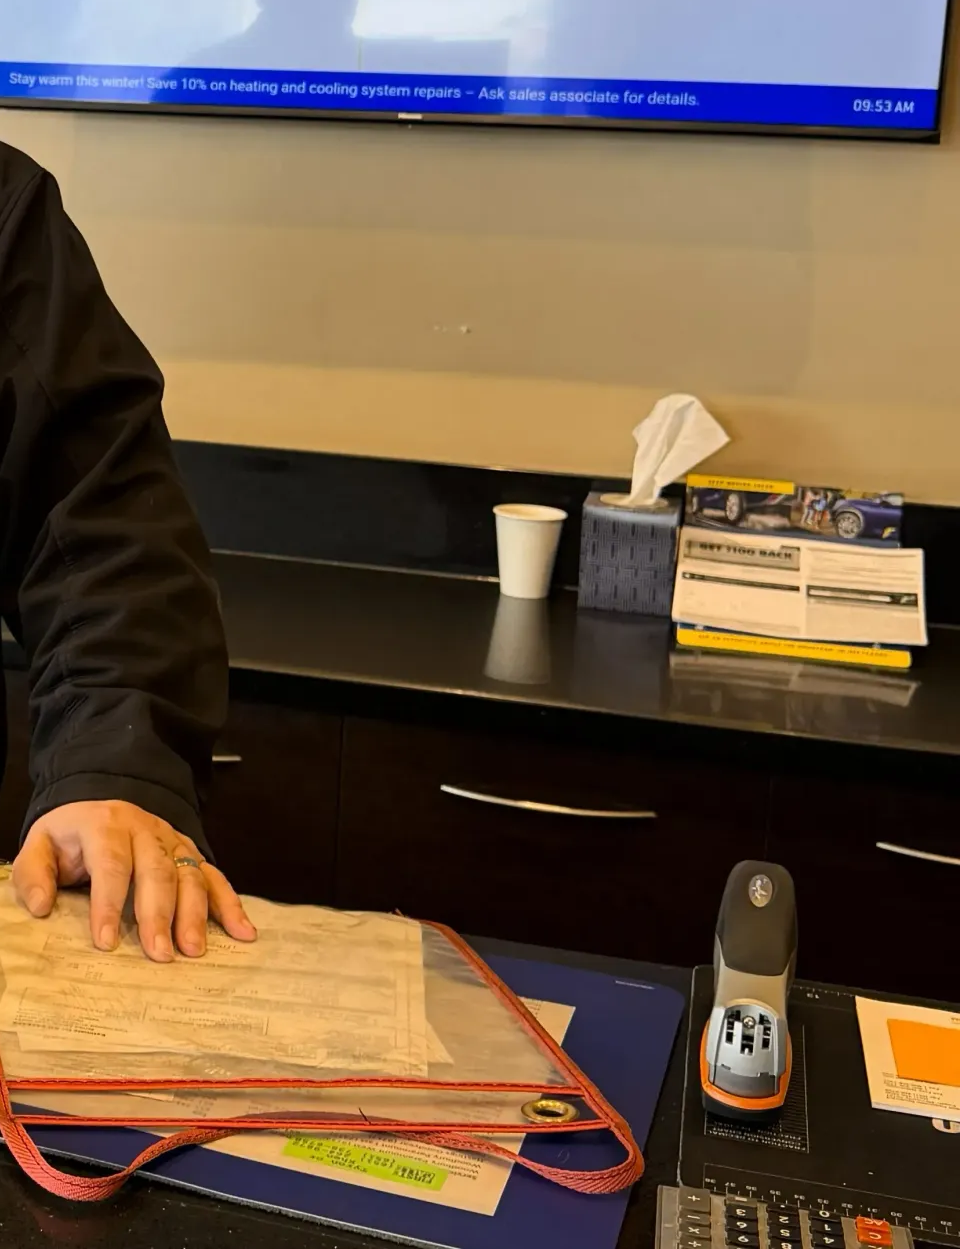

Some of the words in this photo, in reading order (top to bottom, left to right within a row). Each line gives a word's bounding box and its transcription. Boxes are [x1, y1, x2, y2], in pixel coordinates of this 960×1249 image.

[9, 73, 36, 89] Stay
[38, 76, 74, 86] warm
[76, 74, 99, 87] this
[147, 77, 177, 90] Save
[181, 78, 207, 91] 10%
[210, 82, 226, 92] on
[230, 80, 278, 96] heating
[281, 81, 306, 94] and
[309, 82, 358, 98] cooling
[361, 86, 411, 100] system
[414, 87, 461, 101] repairs
[478, 88, 505, 101] Ask
[509, 88, 546, 102] sales
[549, 90, 619, 104] associate
[623, 90, 644, 104] for
[647, 92, 700, 106] details.
[852, 99, 891, 113] 09:53
[894, 101, 915, 114] AM
